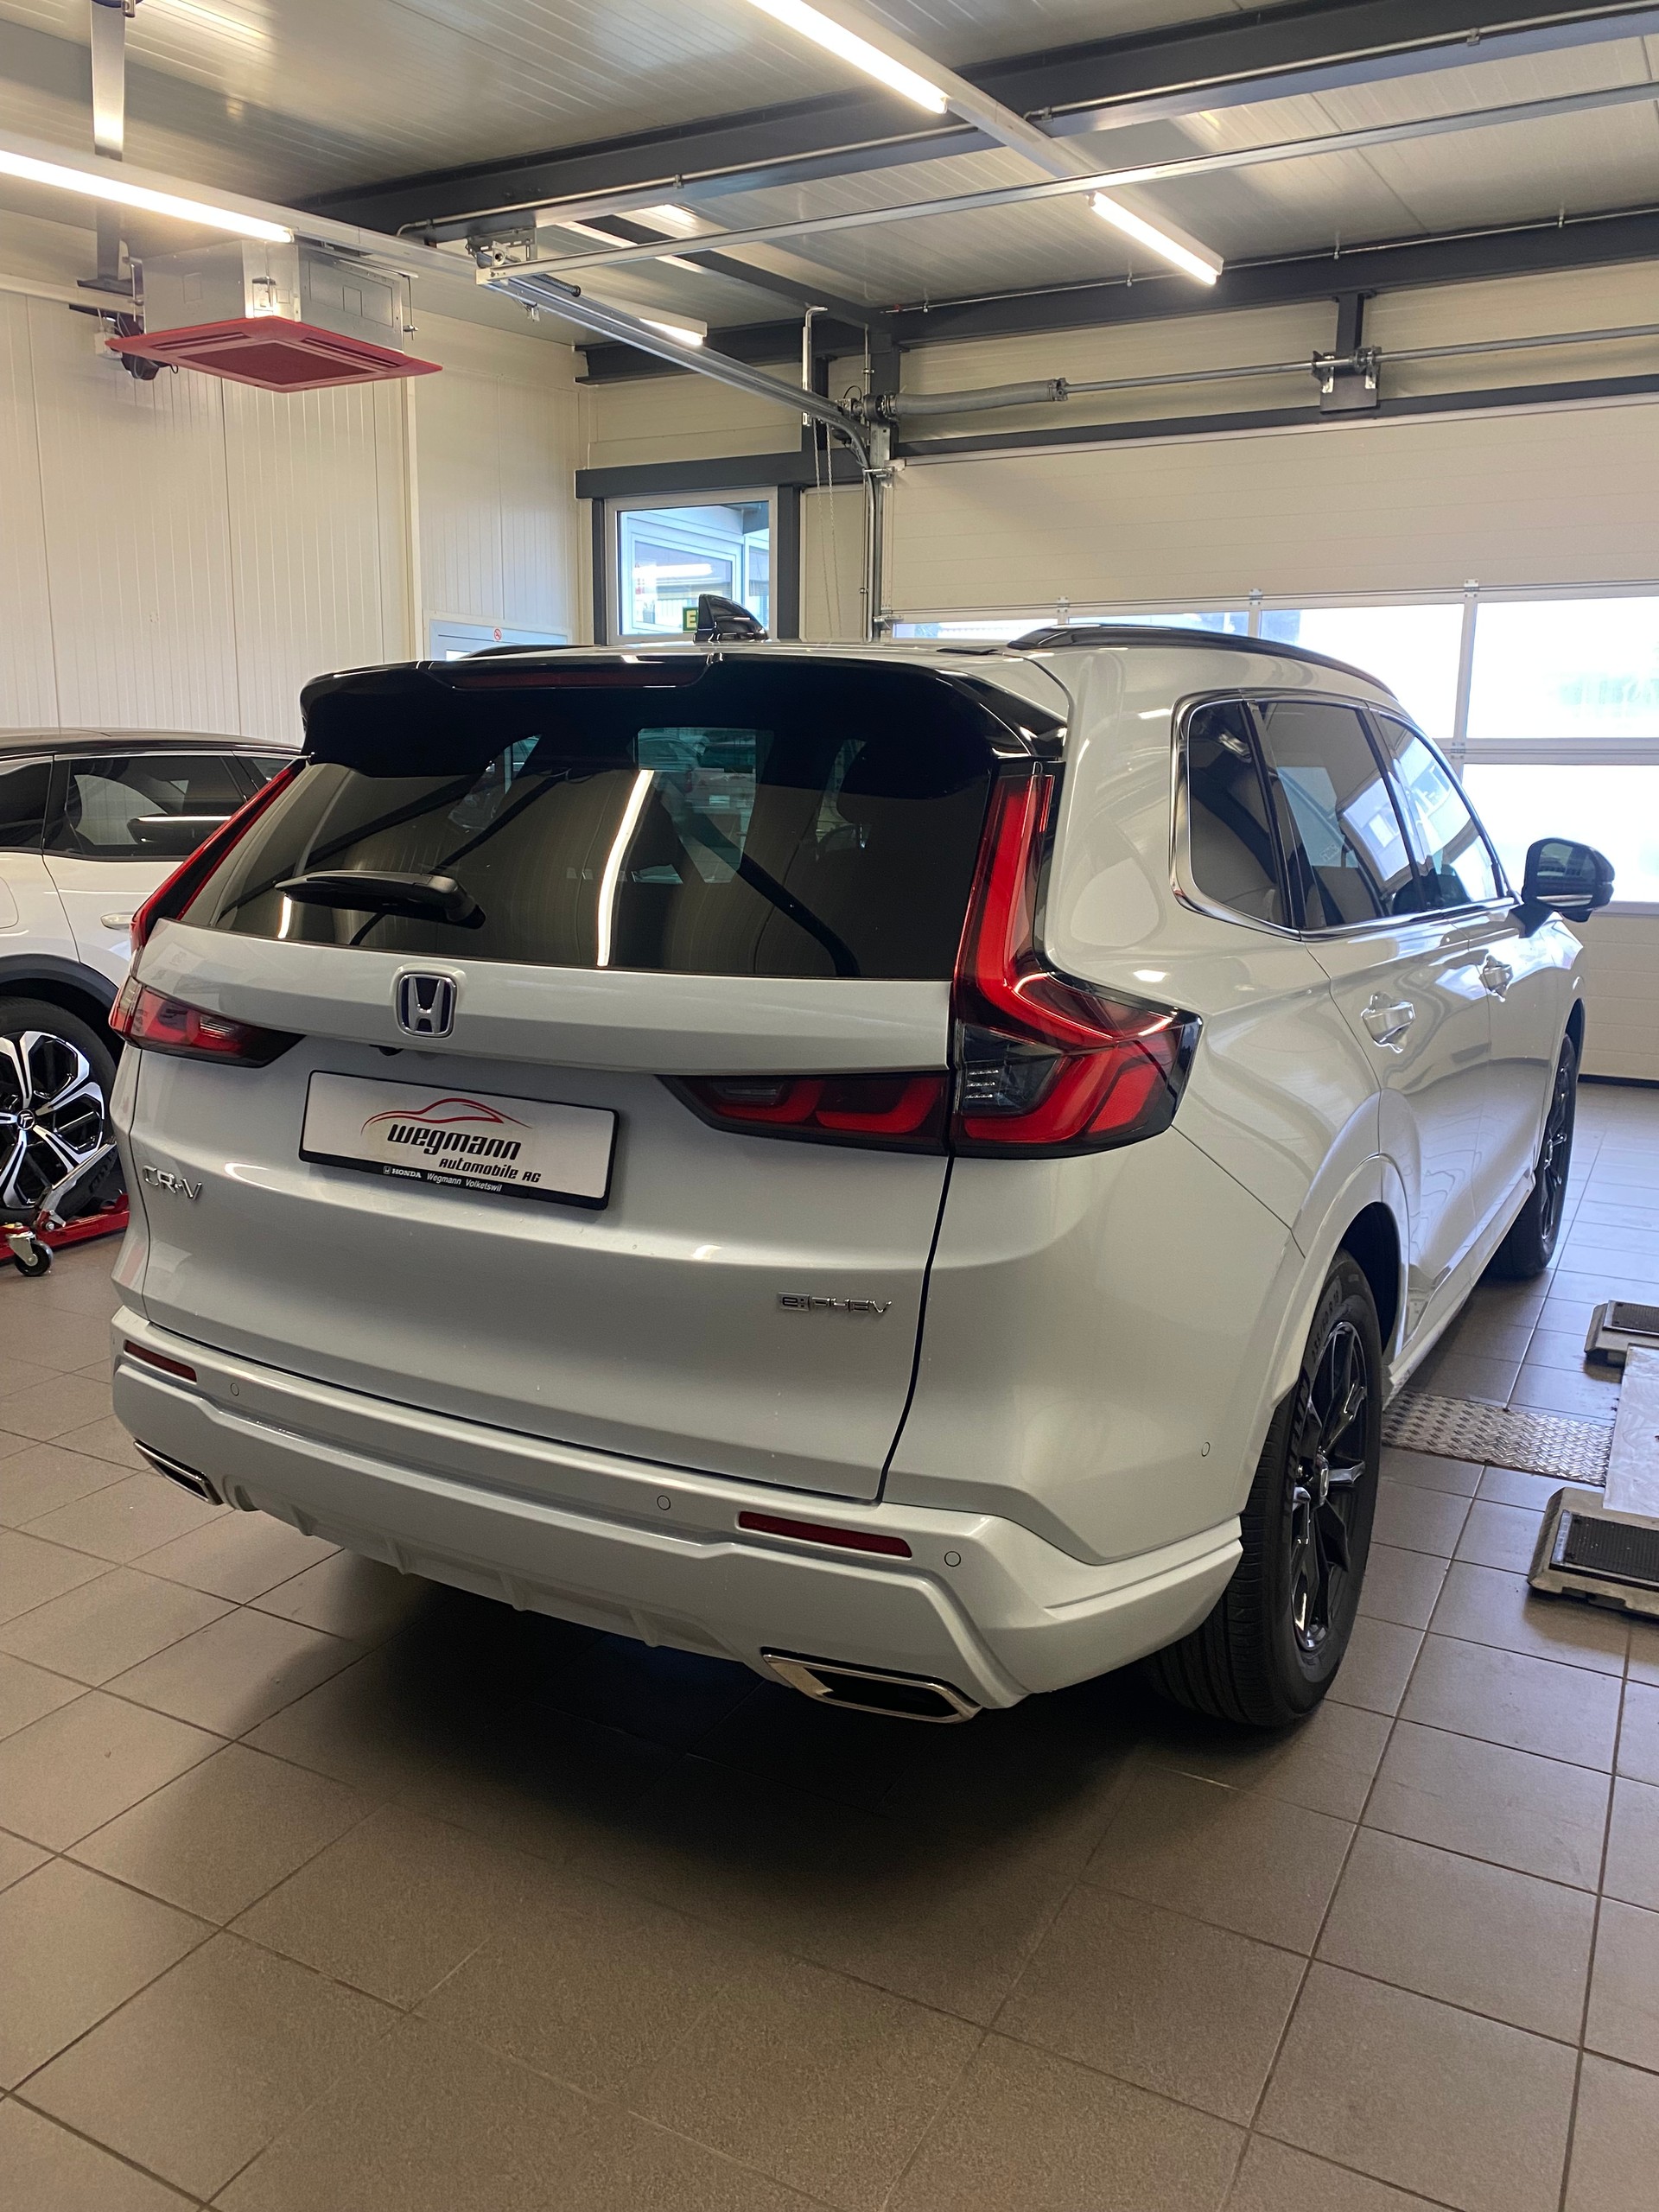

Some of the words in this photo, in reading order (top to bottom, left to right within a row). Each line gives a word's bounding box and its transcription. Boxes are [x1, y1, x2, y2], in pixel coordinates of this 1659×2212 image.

[143, 1165, 203, 1201] CR-V
[391, 1168, 422, 1179] HONDA
[426, 1172, 462, 1185] Wegmann
[465, 1179, 503, 1192] Volketswil
[522, 1171, 542, 1183] AG
